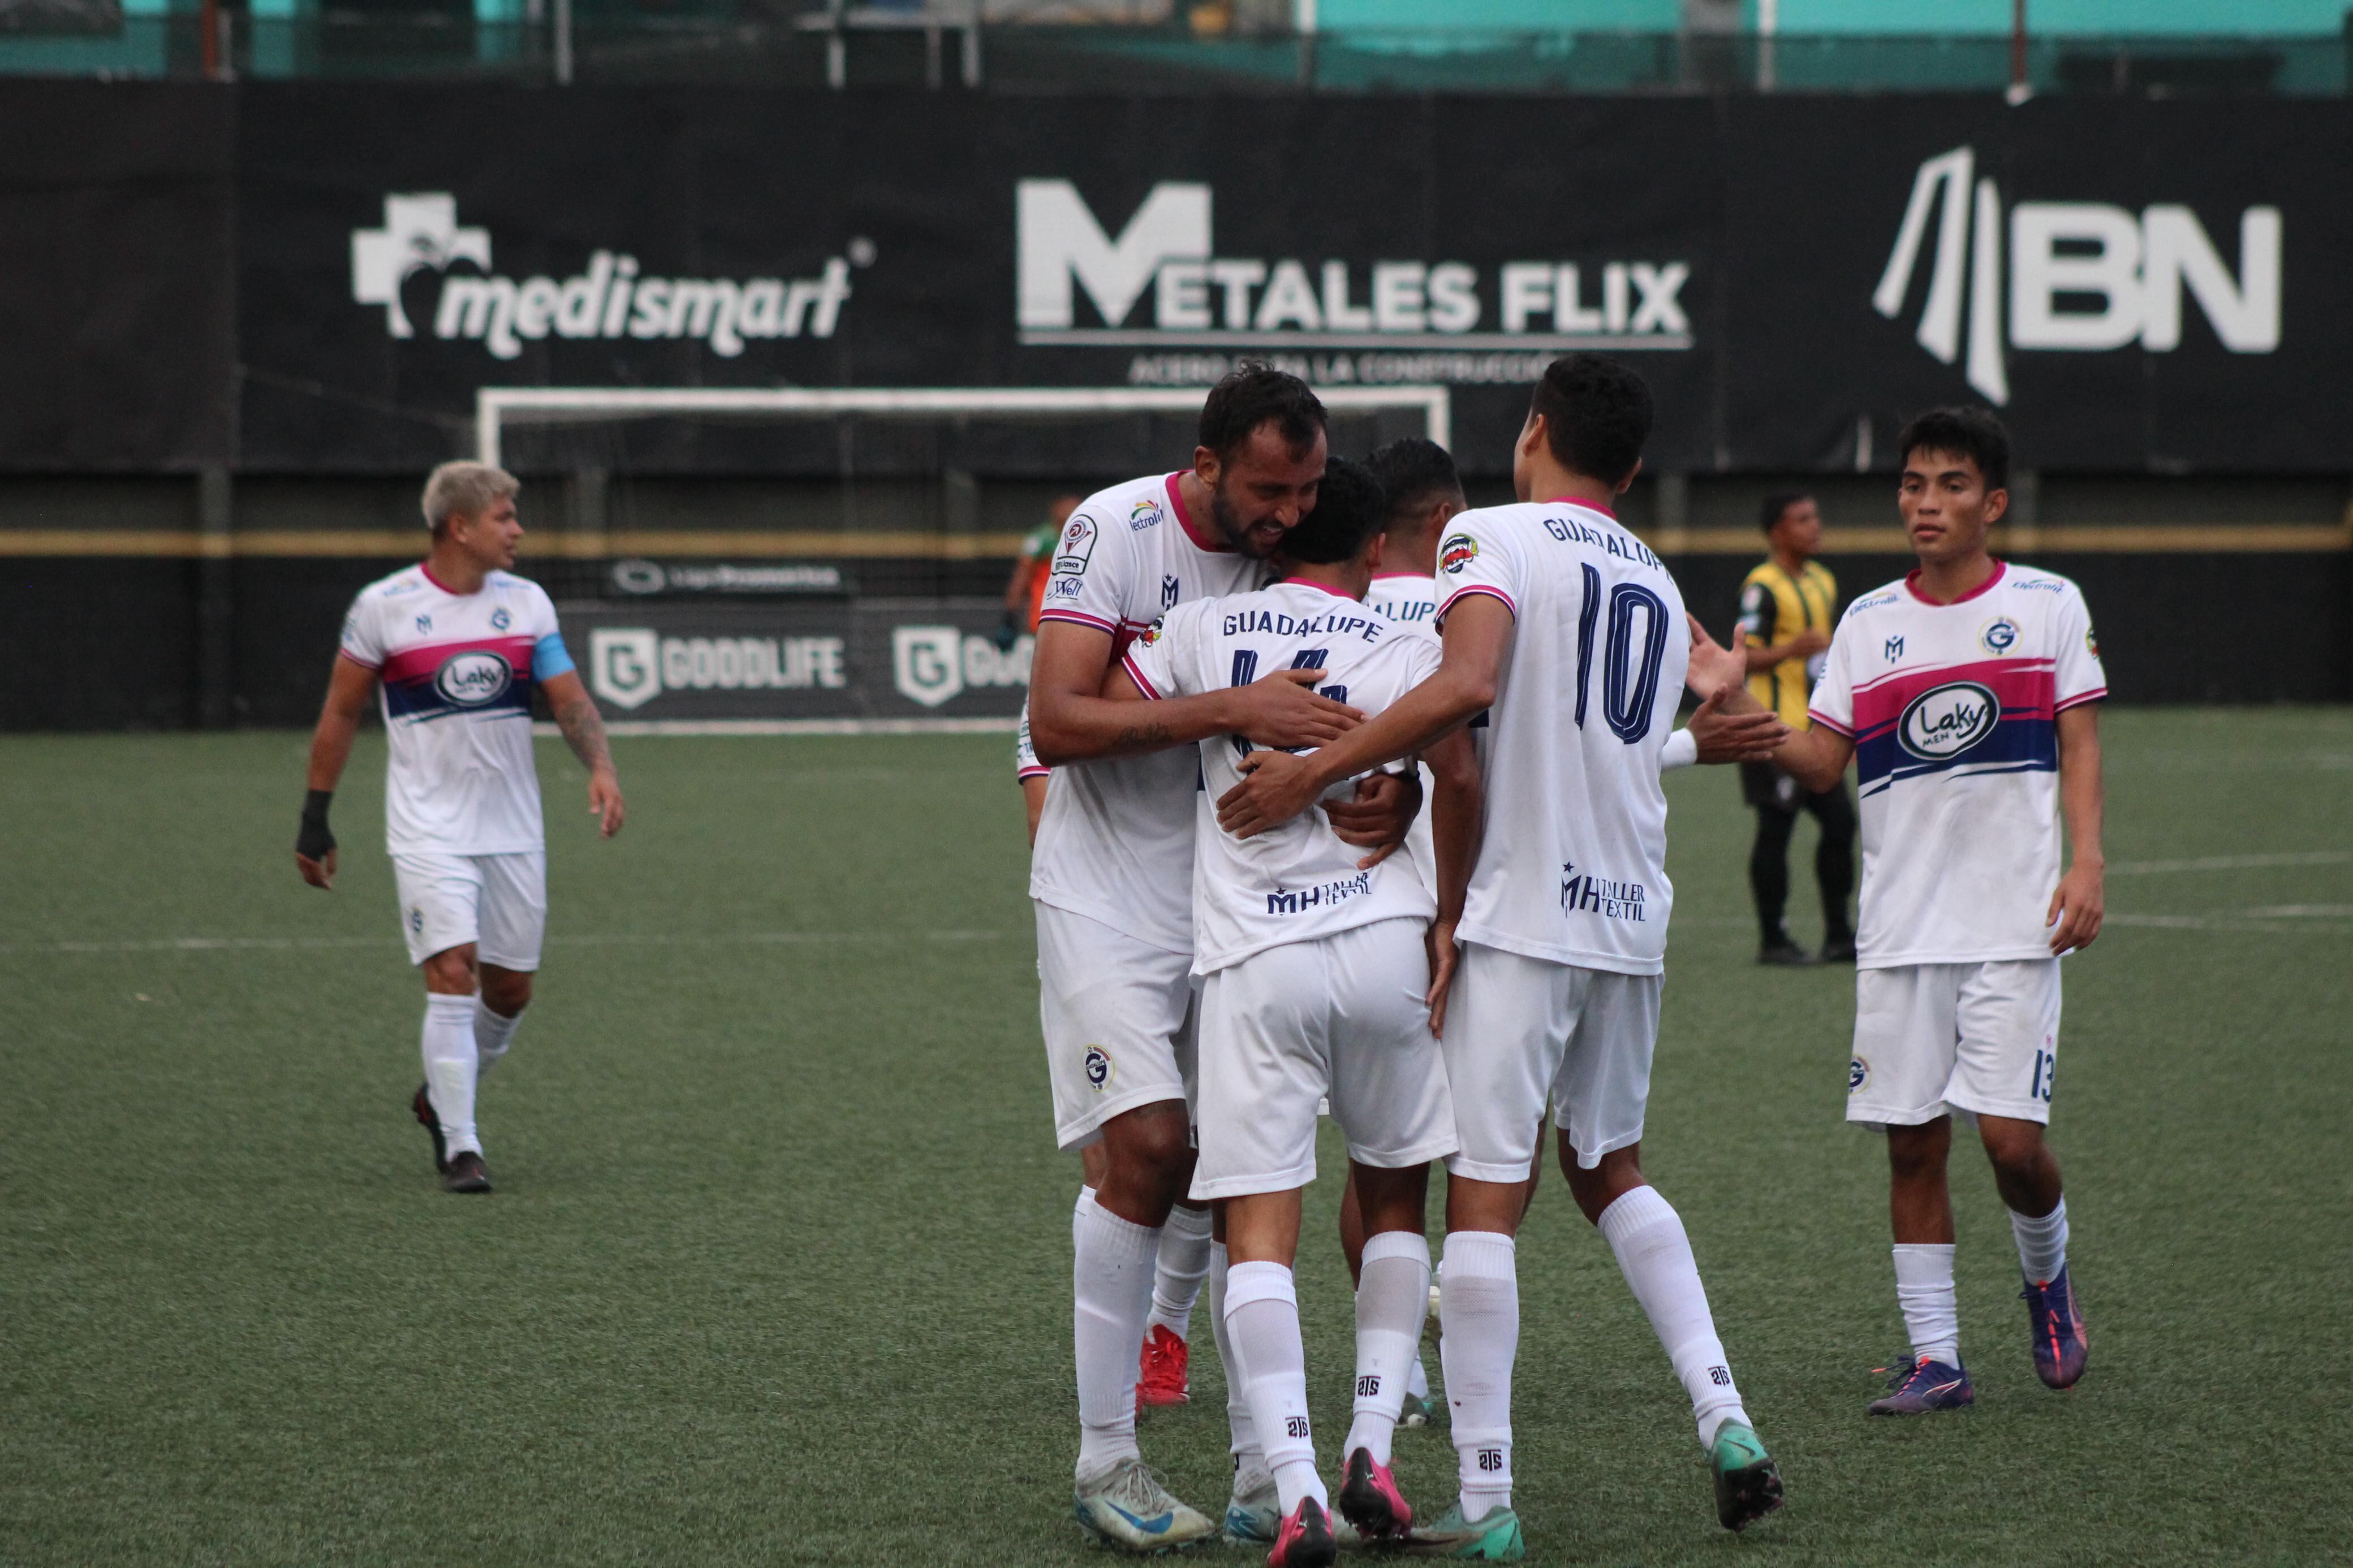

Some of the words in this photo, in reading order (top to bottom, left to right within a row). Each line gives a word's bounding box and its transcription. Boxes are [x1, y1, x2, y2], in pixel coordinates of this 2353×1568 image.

[1016, 178, 1481, 334] METALES
[1499, 262, 1691, 334] FLIX
[2009, 201, 2283, 353] BN
[434, 248, 851, 359] medismart
[1543, 519, 1674, 586] GUADALUP
[1223, 610, 1384, 643] GUADALUPE
[1574, 562, 1669, 744] 10
[661, 636, 847, 690] GOODLIFE
[1920, 702, 1987, 740] Laky
[1922, 732, 1949, 748] MEN
[1601, 879, 1645, 902] TALLER
[1601, 898, 1646, 922] TEXTIL
[2031, 1049, 2055, 1104] 13
